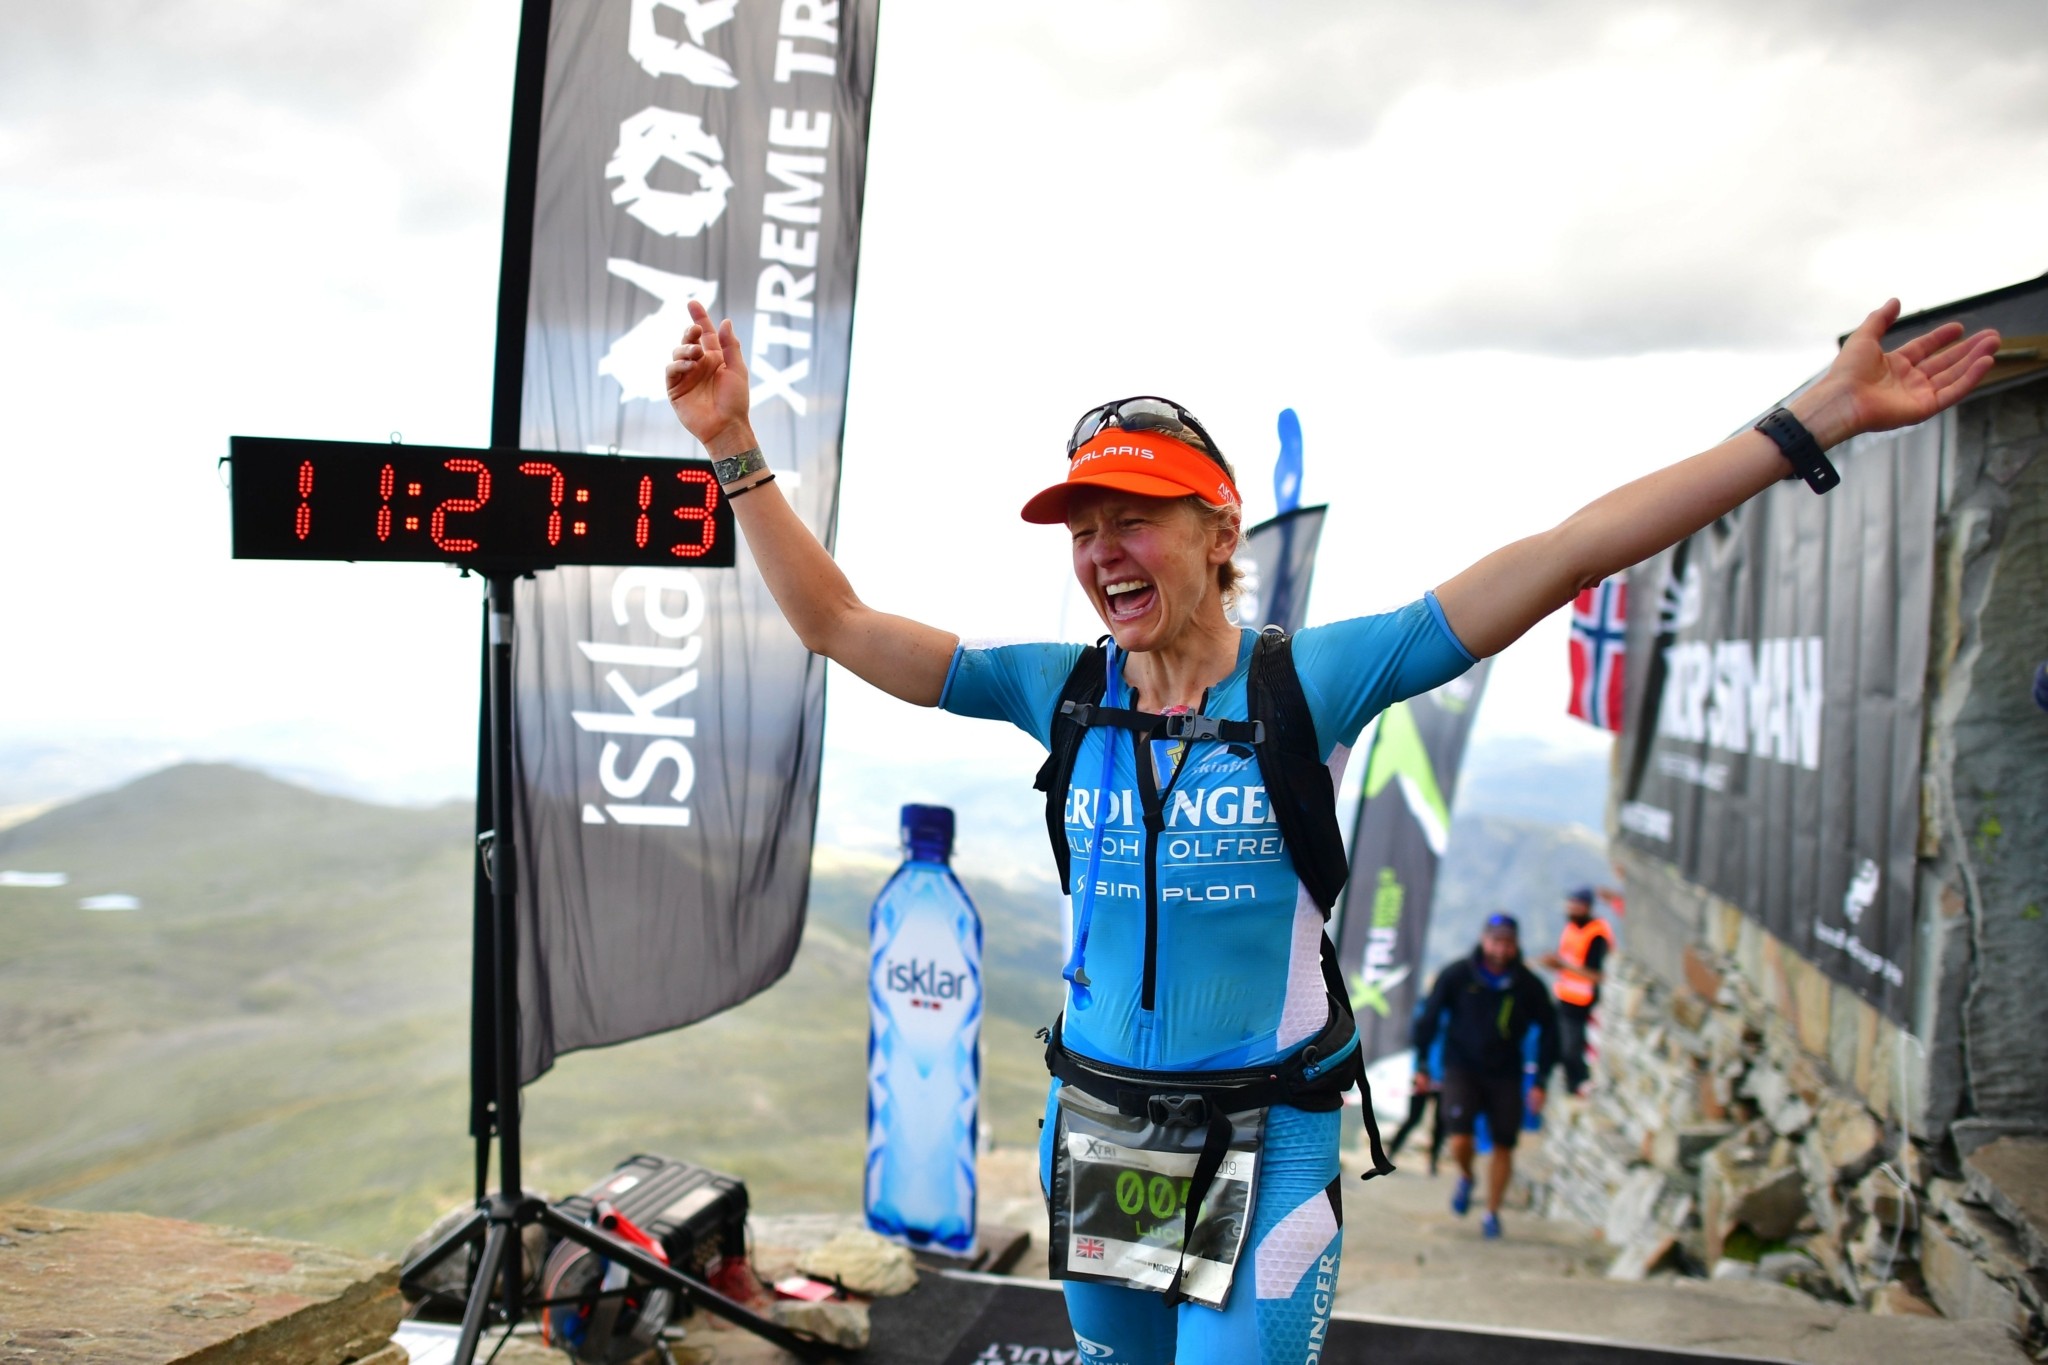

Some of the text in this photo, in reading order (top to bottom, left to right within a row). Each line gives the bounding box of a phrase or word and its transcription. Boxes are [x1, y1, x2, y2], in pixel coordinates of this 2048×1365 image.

[748, 107, 831, 416] XTREME
[1070, 446, 1154, 471] ZALARIS
[571, 567, 705, 827] iskla
[887, 959, 967, 1001] isklar
[1153, 1263, 1190, 1279] NORSEN
